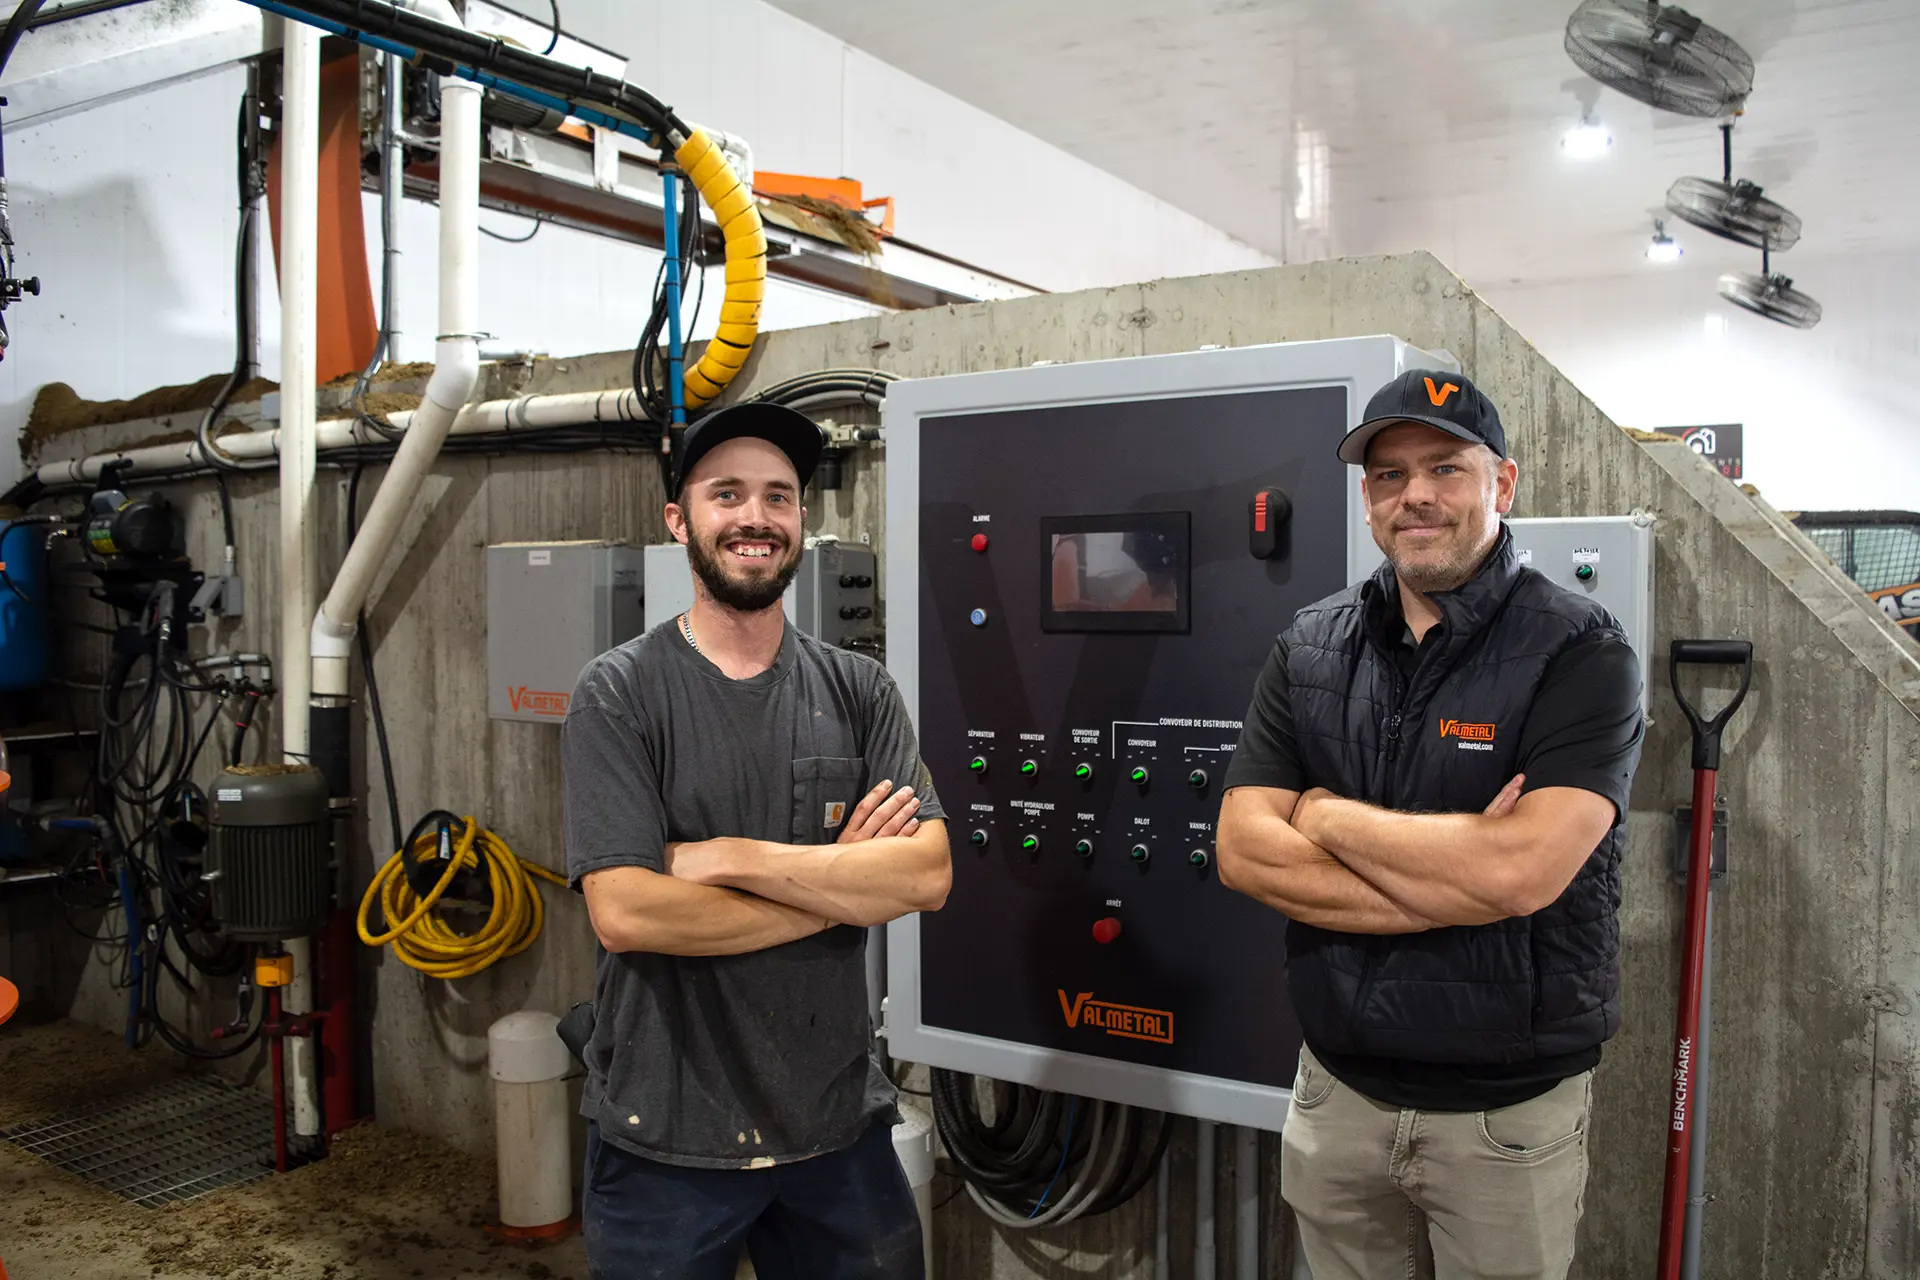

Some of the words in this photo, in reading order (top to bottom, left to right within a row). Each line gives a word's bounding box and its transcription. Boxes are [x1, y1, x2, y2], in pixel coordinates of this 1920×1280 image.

[1159, 717, 1192, 727] CONVOYEUR
[1193, 719, 1201, 728] DE
[1202, 720, 1243, 729] DISTRIBUTION
[1440, 718, 1491, 738] VALMETAL
[968, 729, 995, 738] SÉPARATEUR
[1020, 733, 1045, 741] VIBRATEUR
[1072, 729, 1100, 737] CONVOYEUR
[1128, 739, 1157, 747] CONVOYEUR
[1458, 741, 1493, 751] valmetal.com
[971, 804, 994, 812] AGITATEUR
[1024, 802, 1055, 810] HYDRAULIQUE
[1134, 817, 1150, 825] DALOT
[1188, 822, 1211, 831] VANNE-1
[1058, 989, 1167, 1037] VALMETAL
[1673, 1037, 1692, 1132] BENCHMARK
